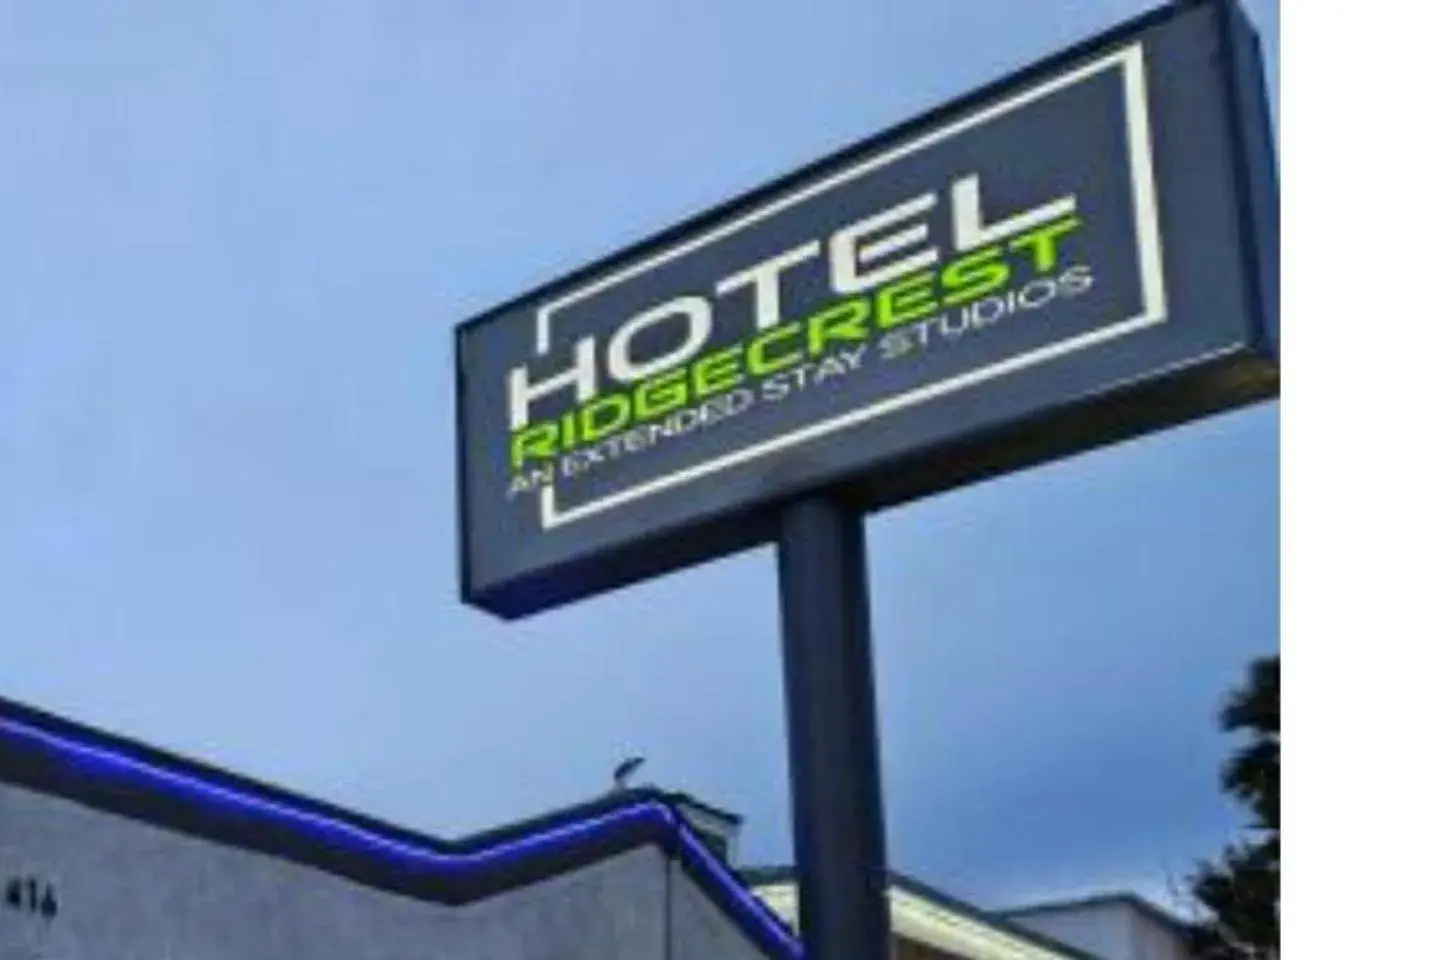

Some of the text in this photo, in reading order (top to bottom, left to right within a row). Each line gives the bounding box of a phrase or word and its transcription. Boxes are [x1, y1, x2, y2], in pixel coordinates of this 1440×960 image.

[507, 172, 1077, 431] HOTEL
[508, 264, 1094, 497] AN EXTENDED STAY STUDIOS
[509, 218, 1082, 467] RIDGECREST
